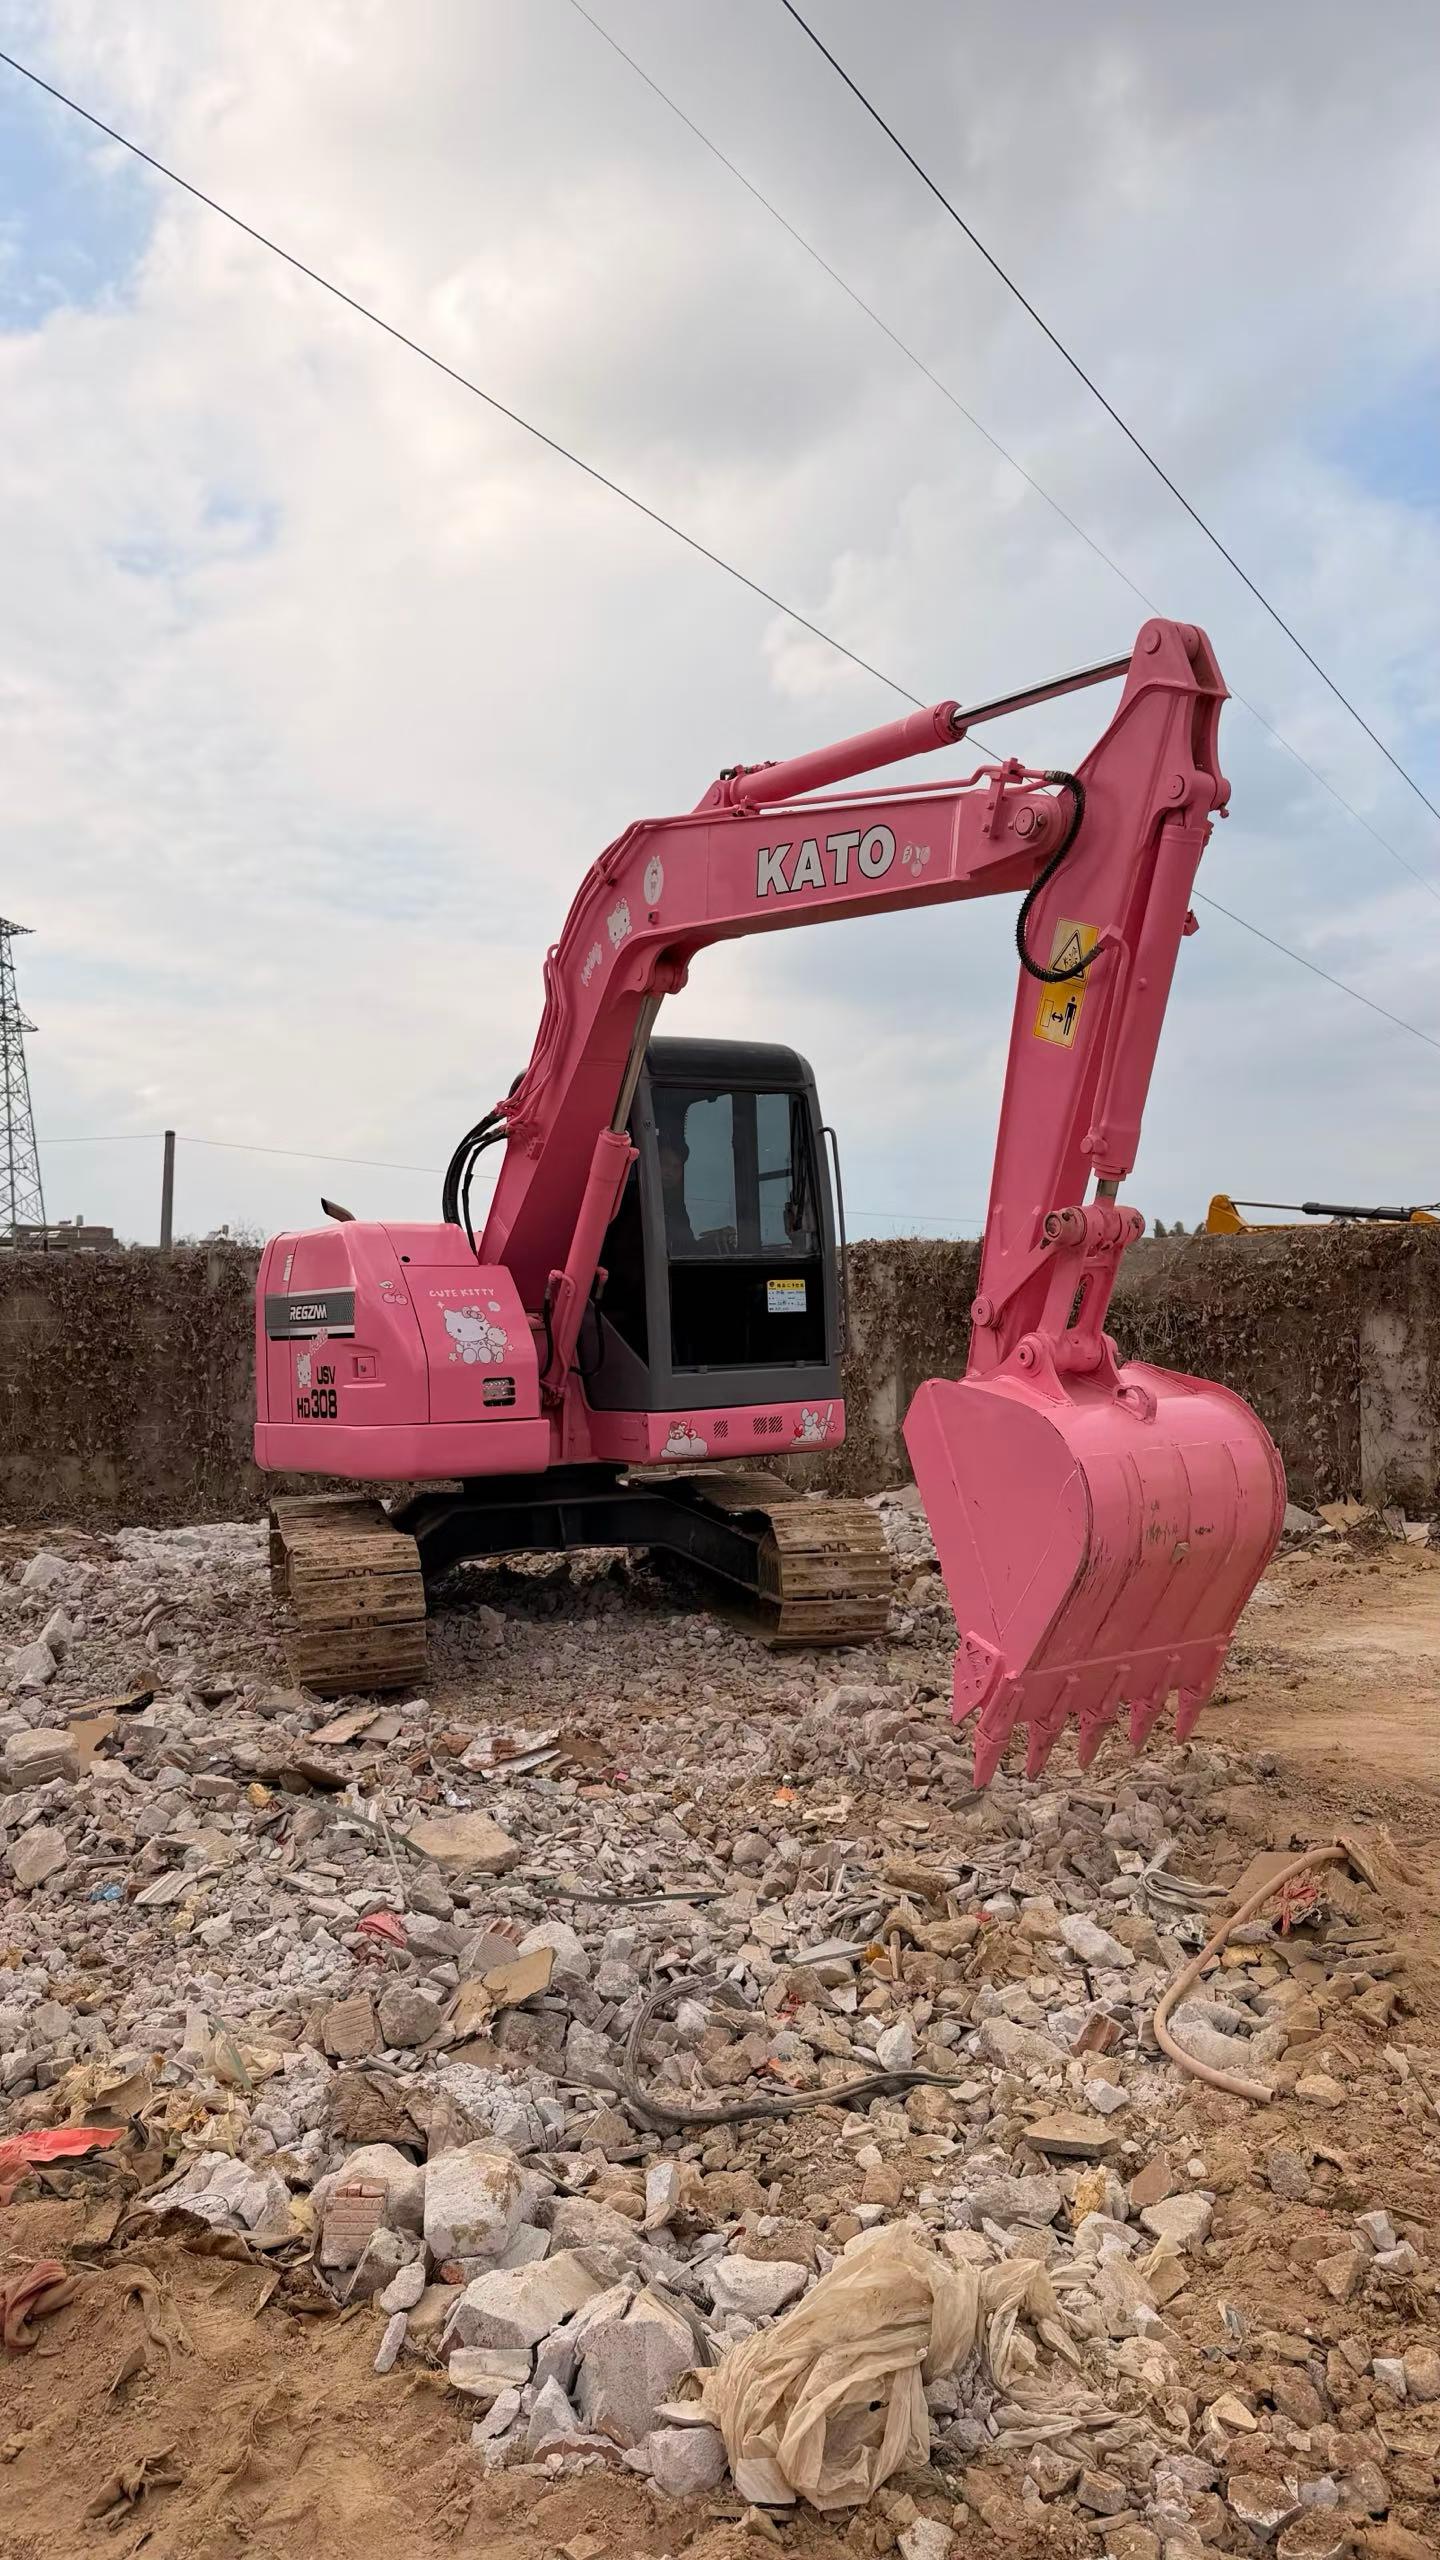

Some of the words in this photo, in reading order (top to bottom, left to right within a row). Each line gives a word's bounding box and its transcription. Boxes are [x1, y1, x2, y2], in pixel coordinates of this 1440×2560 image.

[756, 824, 897, 897] KATO
[429, 1289, 458, 1297] CUTE
[460, 1288, 494, 1296] KITTY
[316, 1366, 336, 1384] USV
